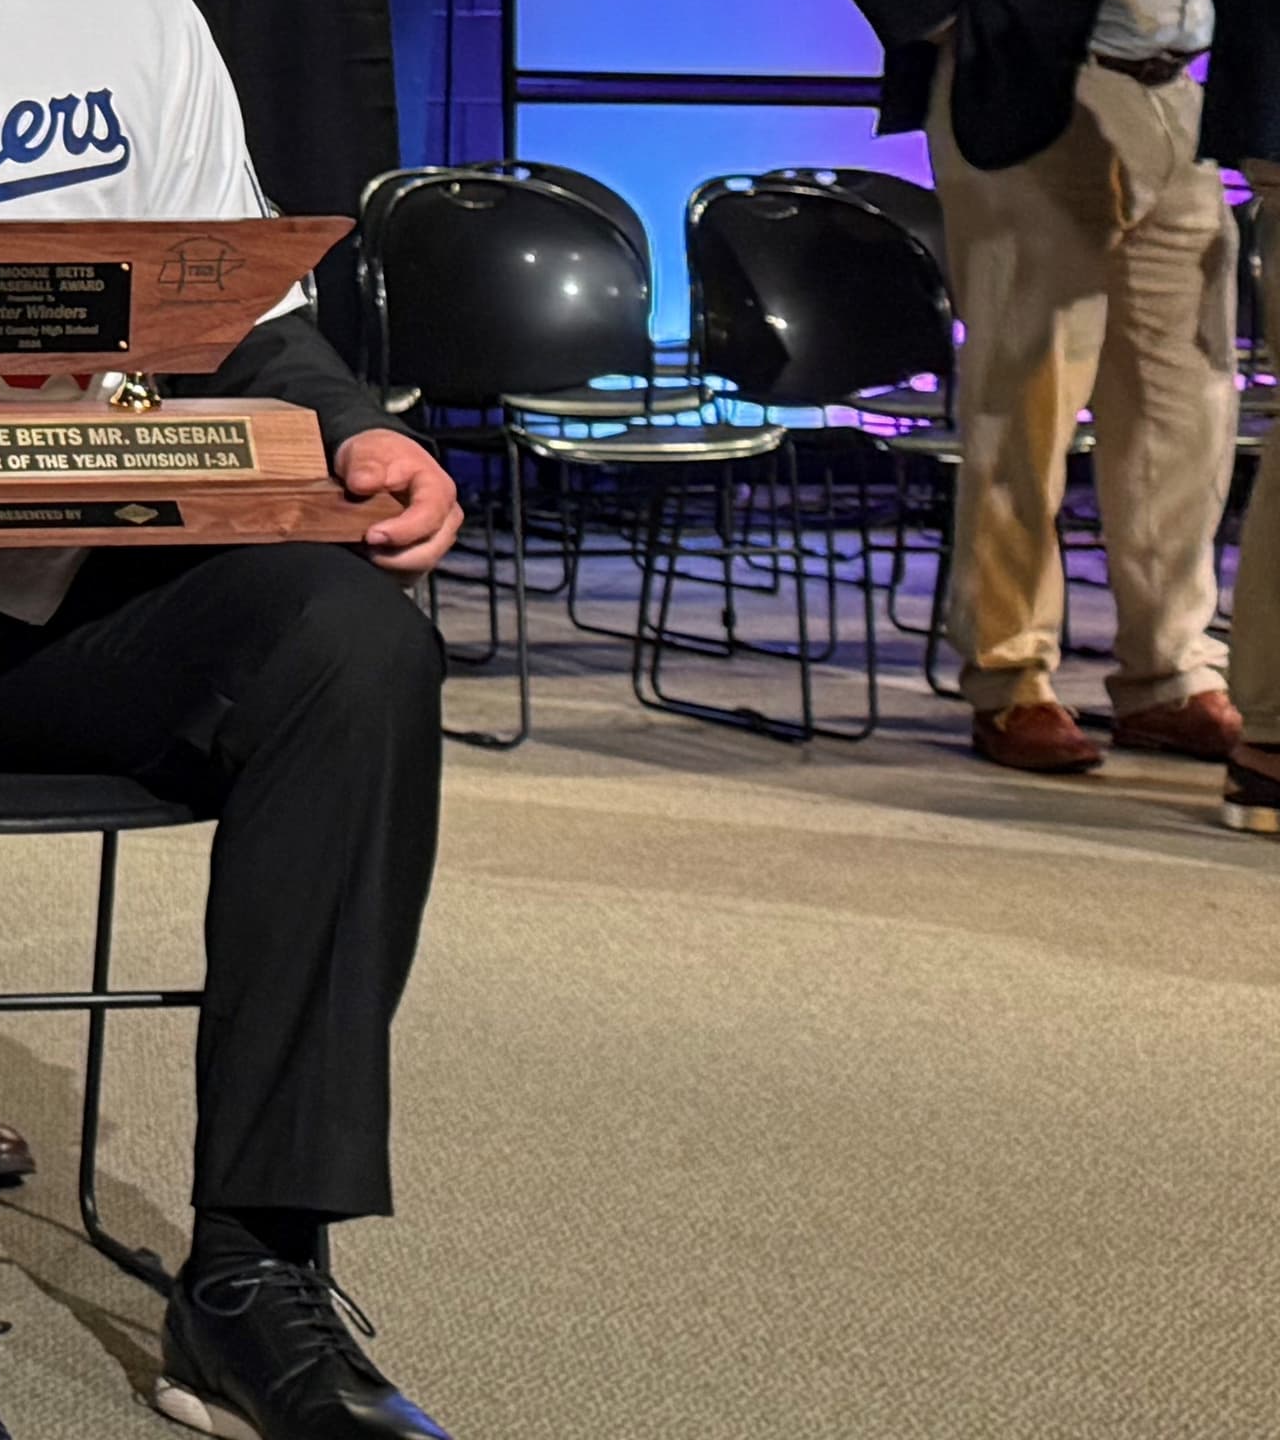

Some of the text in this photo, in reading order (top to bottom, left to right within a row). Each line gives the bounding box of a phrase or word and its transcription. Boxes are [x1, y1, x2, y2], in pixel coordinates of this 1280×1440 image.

[0, 268, 49, 278] MOOKIE
[56, 267, 94, 278] BETTS
[60, 280, 104, 291] AWARD
[27, 306, 87, 319] Winders
[17, 428, 82, 447] BETTS
[90, 427, 130, 446] MR.
[136, 425, 244, 444] BASEBALL
[8, 455, 30, 469] OF
[36, 455, 68, 468] THE
[73, 454, 118, 468] YEAR
[124, 453, 199, 468] DIVISION
[206, 453, 239, 467] I-3A
[65, 509, 82, 520] BY
